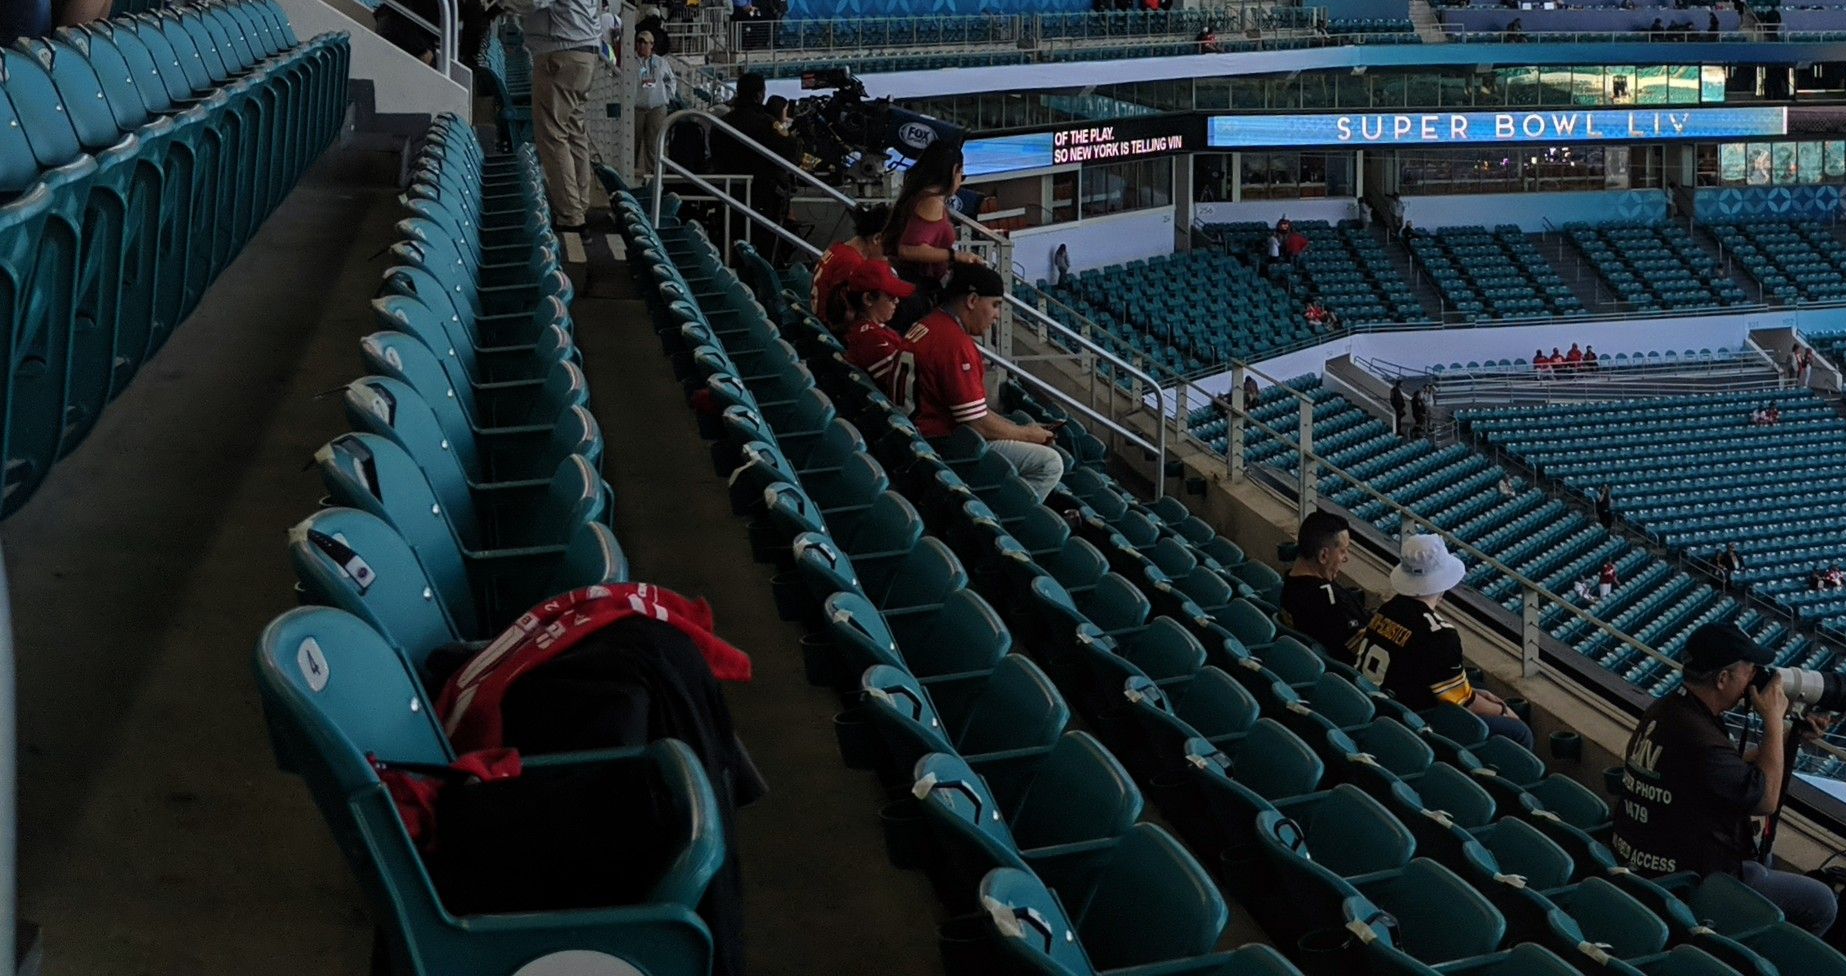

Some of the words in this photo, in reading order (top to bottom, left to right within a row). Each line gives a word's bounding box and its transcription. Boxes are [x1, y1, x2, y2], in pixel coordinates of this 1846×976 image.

[908, 127, 929, 141] FOX
[1055, 132, 1068, 145] OF
[1070, 130, 1088, 145] THE
[1090, 128, 1114, 144] PLAY.
[1337, 115, 1468, 141] SUPER
[1496, 113, 1602, 138] BOWL
[1629, 112, 1689, 137] LIV
[1055, 149, 1068, 163] SO
[1070, 146, 1091, 162] NEW
[1093, 143, 1119, 160] YORK
[1121, 142, 1130, 156] IS
[1131, 137, 1166, 155] TELLING
[1168, 135, 1182, 150] VIN
[1636, 782, 1673, 804] PHOTO
[1630, 849, 1676, 873] ACCESS
